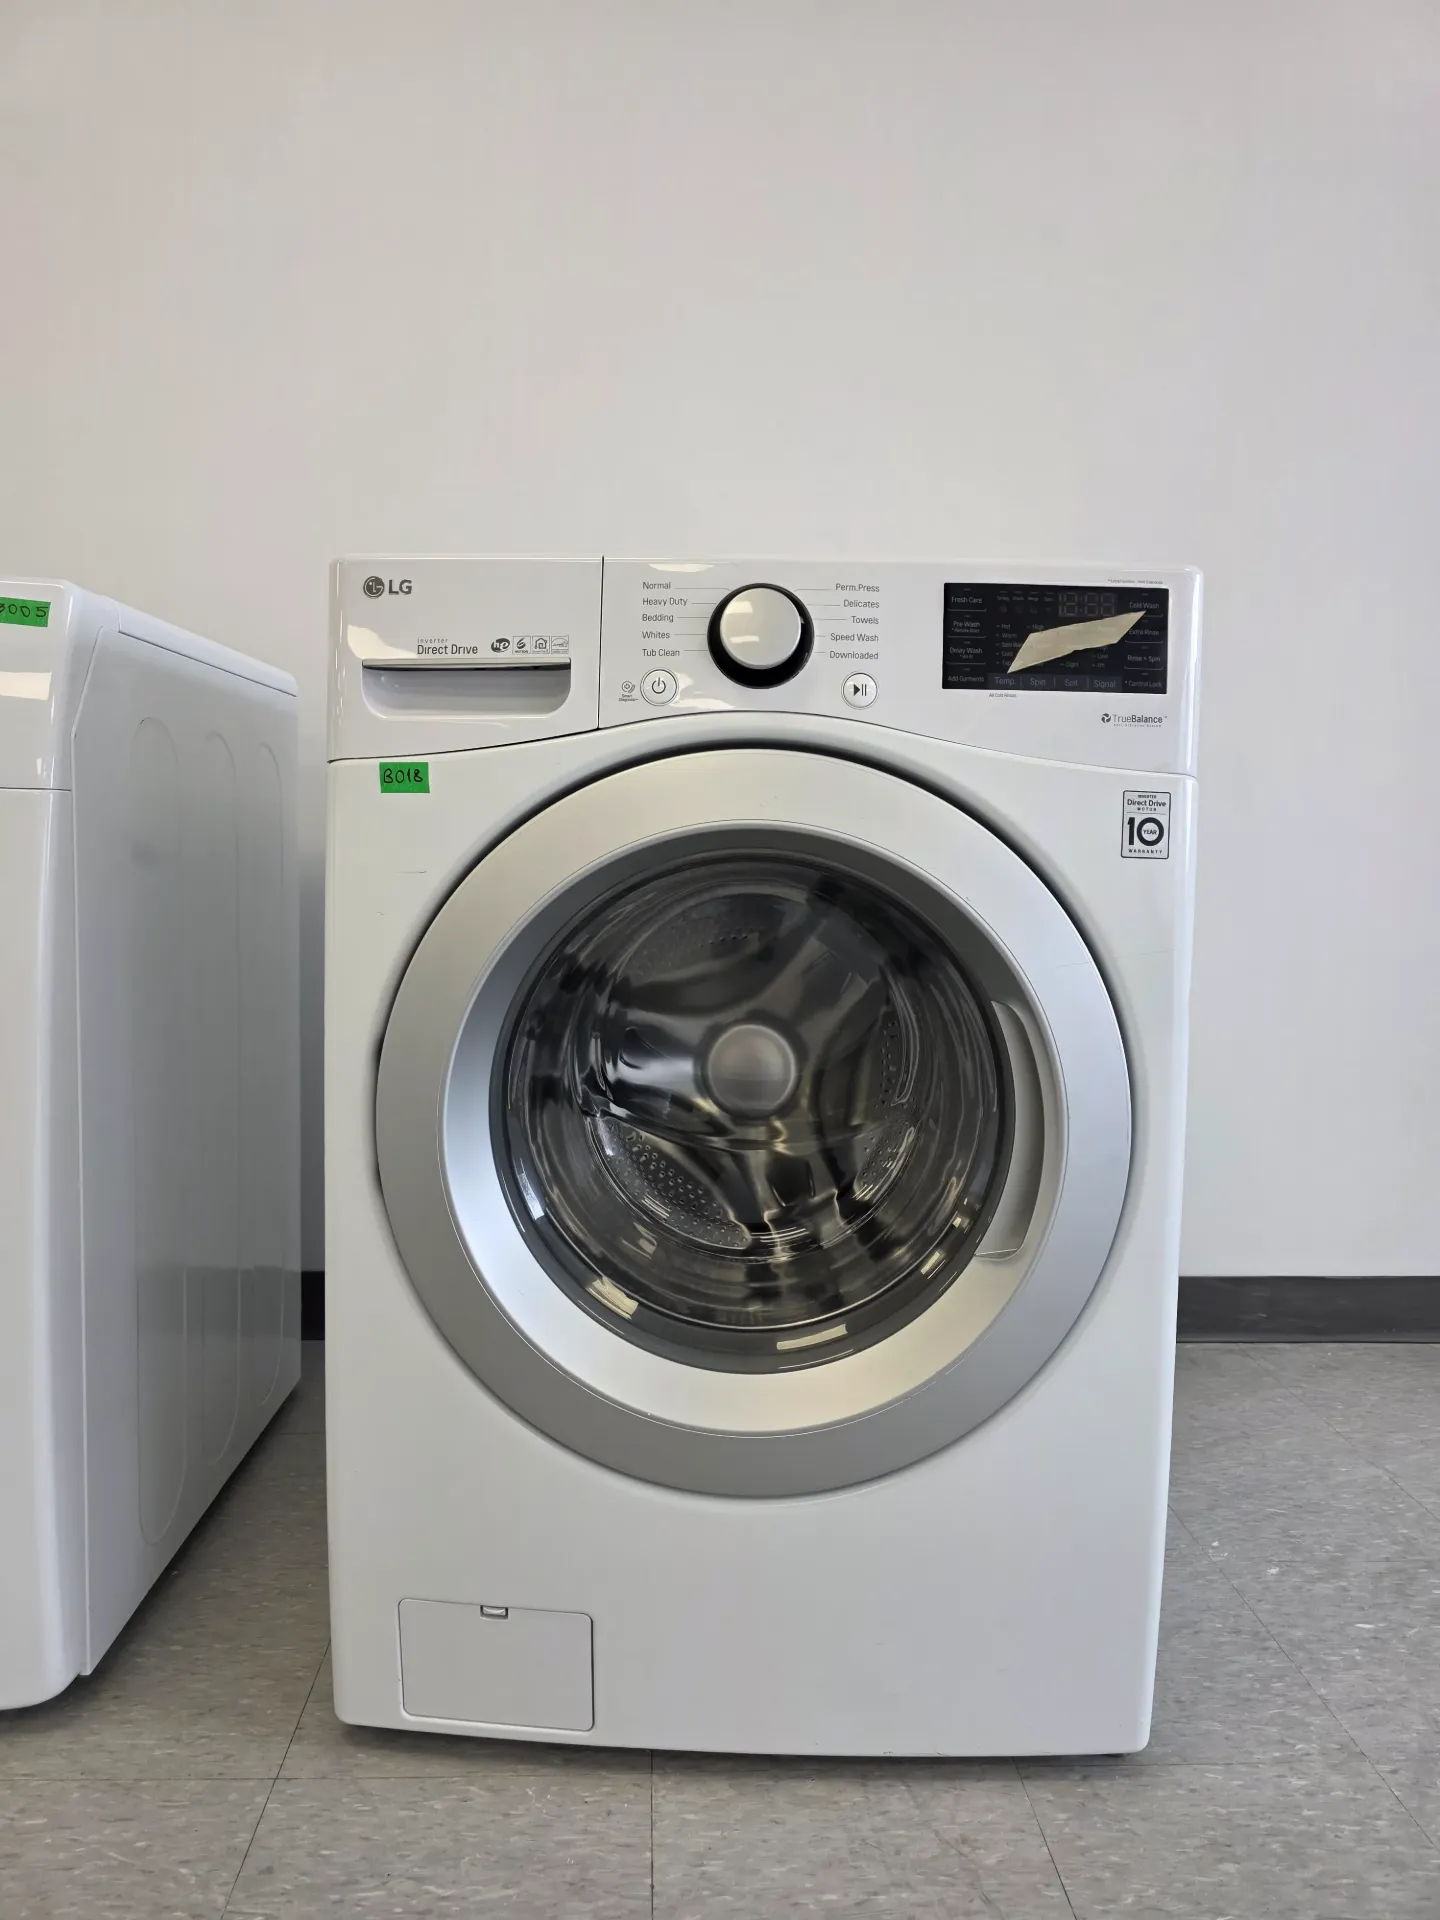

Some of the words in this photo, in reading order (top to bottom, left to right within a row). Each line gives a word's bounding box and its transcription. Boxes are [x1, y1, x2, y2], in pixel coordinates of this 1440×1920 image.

[389, 579, 412, 595] LG
[643, 582, 671, 590] Normal
[836, 583, 880, 592] Perm.Press
[643, 598, 667, 606] Heavy
[670, 597, 688, 606] Duty
[844, 599, 880, 609] Delicates
[968, 596, 982, 604] Care
[642, 614, 674, 623] Bedding
[851, 616, 879, 625] Towels
[642, 631, 671, 639] Whites
[830, 632, 855, 642] Speed
[857, 634, 879, 642] Wash
[417, 644, 449, 655] Direct
[450, 644, 479, 655] Drive
[642, 648, 657, 656] Tub
[658, 649, 680, 657] Clean
[949, 647, 965, 655] Delay
[829, 650, 879, 660] Downloaded
[994, 677, 1018, 687] Temp.
[1029, 678, 1047, 687] Spin
[1064, 679, 1078, 687] Soil
[1093, 680, 1117, 689] Signal
[1127, 798, 1148, 806] Direct
[1127, 816, 1165, 847] 10
